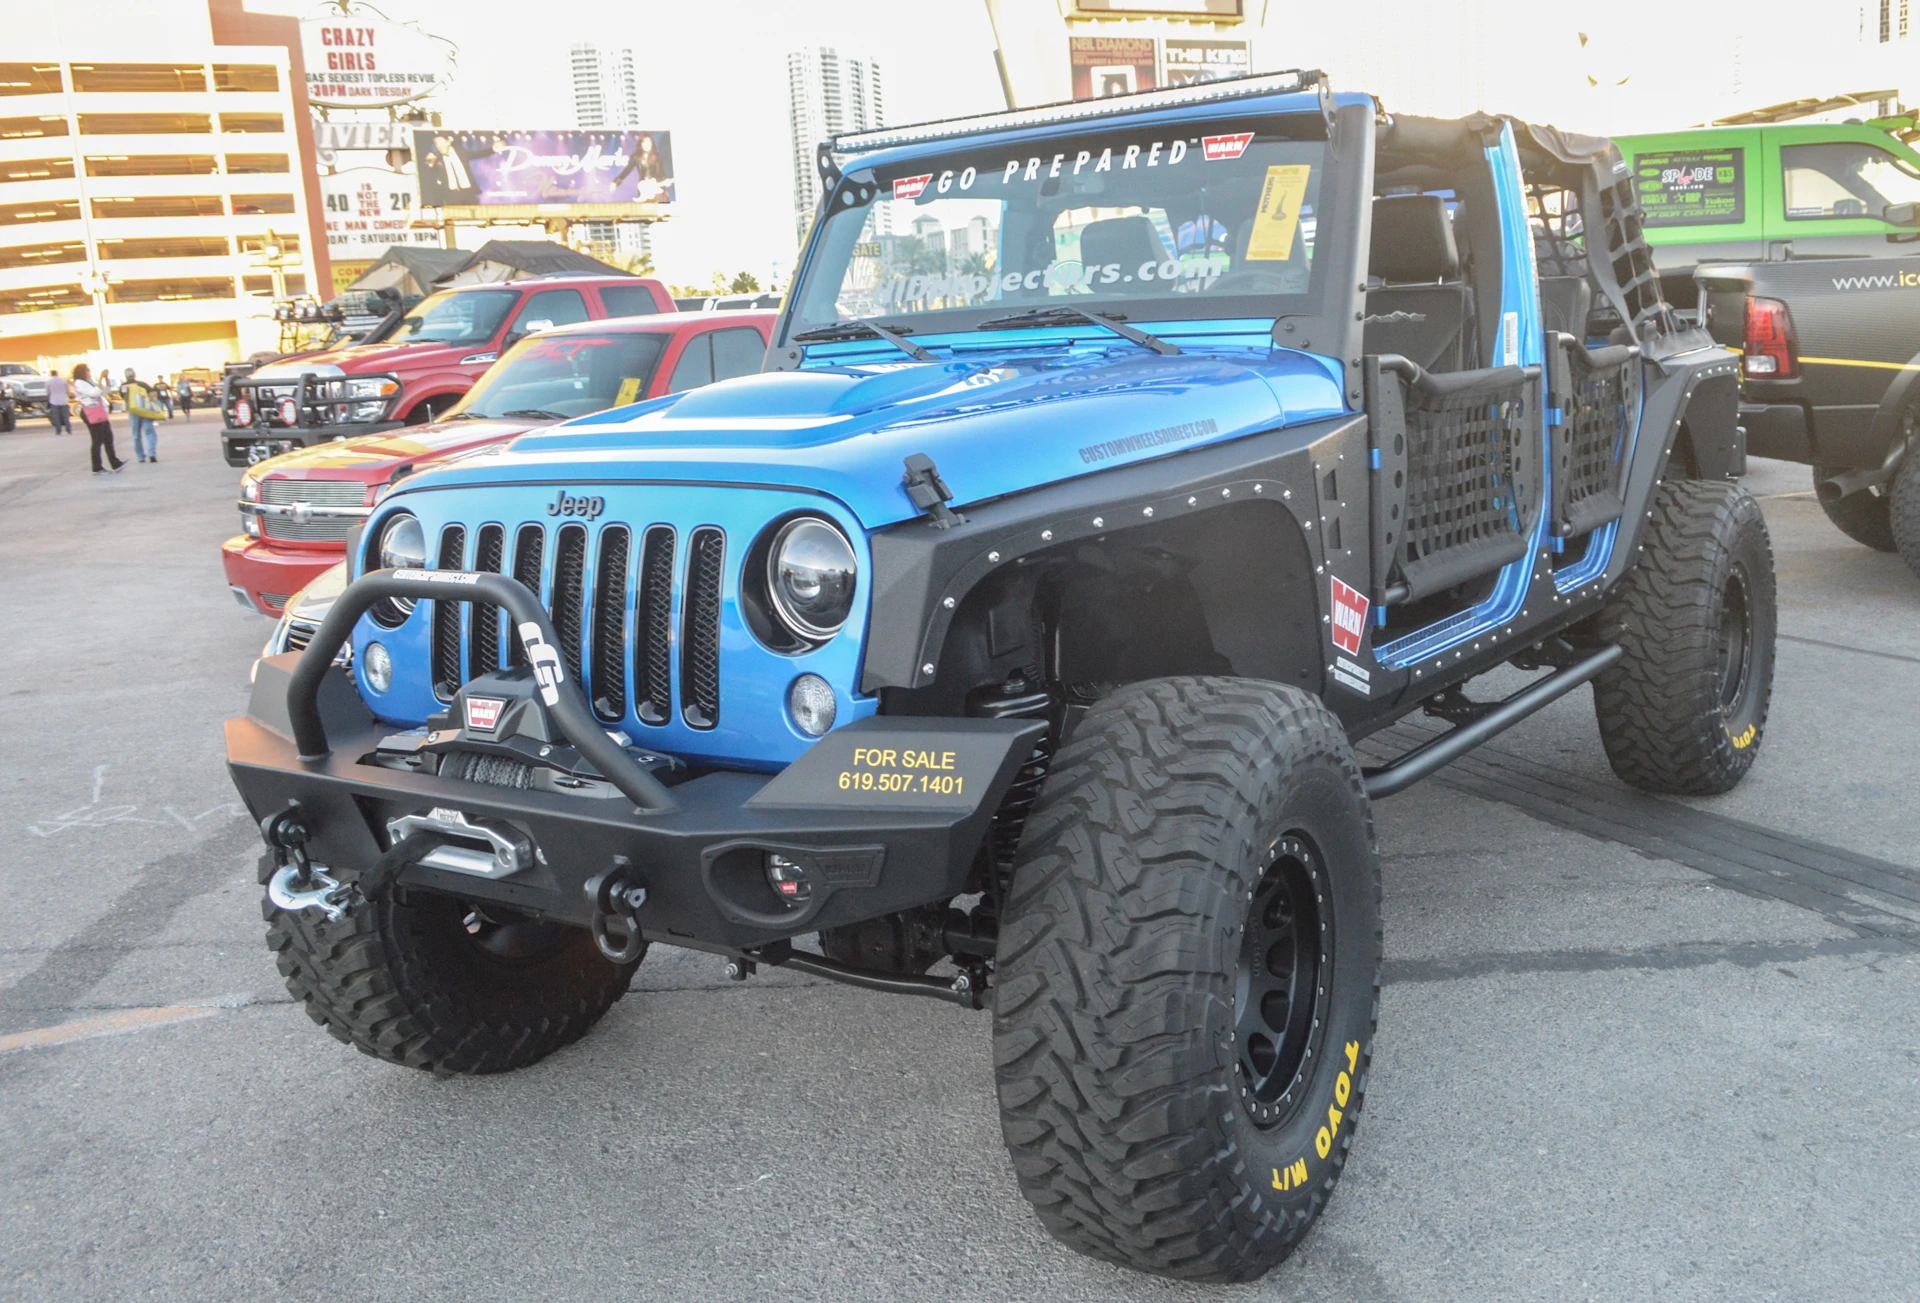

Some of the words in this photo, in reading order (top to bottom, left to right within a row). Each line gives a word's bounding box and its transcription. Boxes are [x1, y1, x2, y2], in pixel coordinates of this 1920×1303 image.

[321, 27, 375, 47] CRAZY
[1099, 38, 1151, 50] DIAMOND
[327, 52, 376, 71] GIRLS
[1167, 48, 1202, 62] THE
[1206, 48, 1247, 63] KING
[328, 73, 364, 83] SEXIEST
[368, 73, 406, 83] TOPLESS
[407, 73, 436, 83] REVUE
[348, 87, 372, 97] DARK
[374, 86, 412, 97] TUESDAY
[319, 122, 412, 149] IVIER
[937, 167, 976, 194] GO
[1003, 140, 1187, 184] PREPARED
[1207, 139, 1244, 155] WARN
[357, 191, 378, 199] NOT
[361, 183, 372, 191] IS
[326, 194, 349, 212] 40
[359, 200, 379, 208] THE
[359, 208, 381, 217] NEW
[326, 222, 339, 231] NE
[345, 221, 367, 230] MAN
[360, 233, 408, 244] SATURDAY
[1078, 418, 1219, 464] CUSTOMWHEELSDIRECT.COM
[546, 490, 606, 522] Jeep
[1334, 599, 1362, 637] WARN
[853, 748, 897, 767] FOR
[901, 750, 956, 770] SALE
[838, 771, 963, 795] 619.507.1401
[1315, 1040, 1360, 1160] TOYO
[1272, 1157, 1308, 1191] M/T
